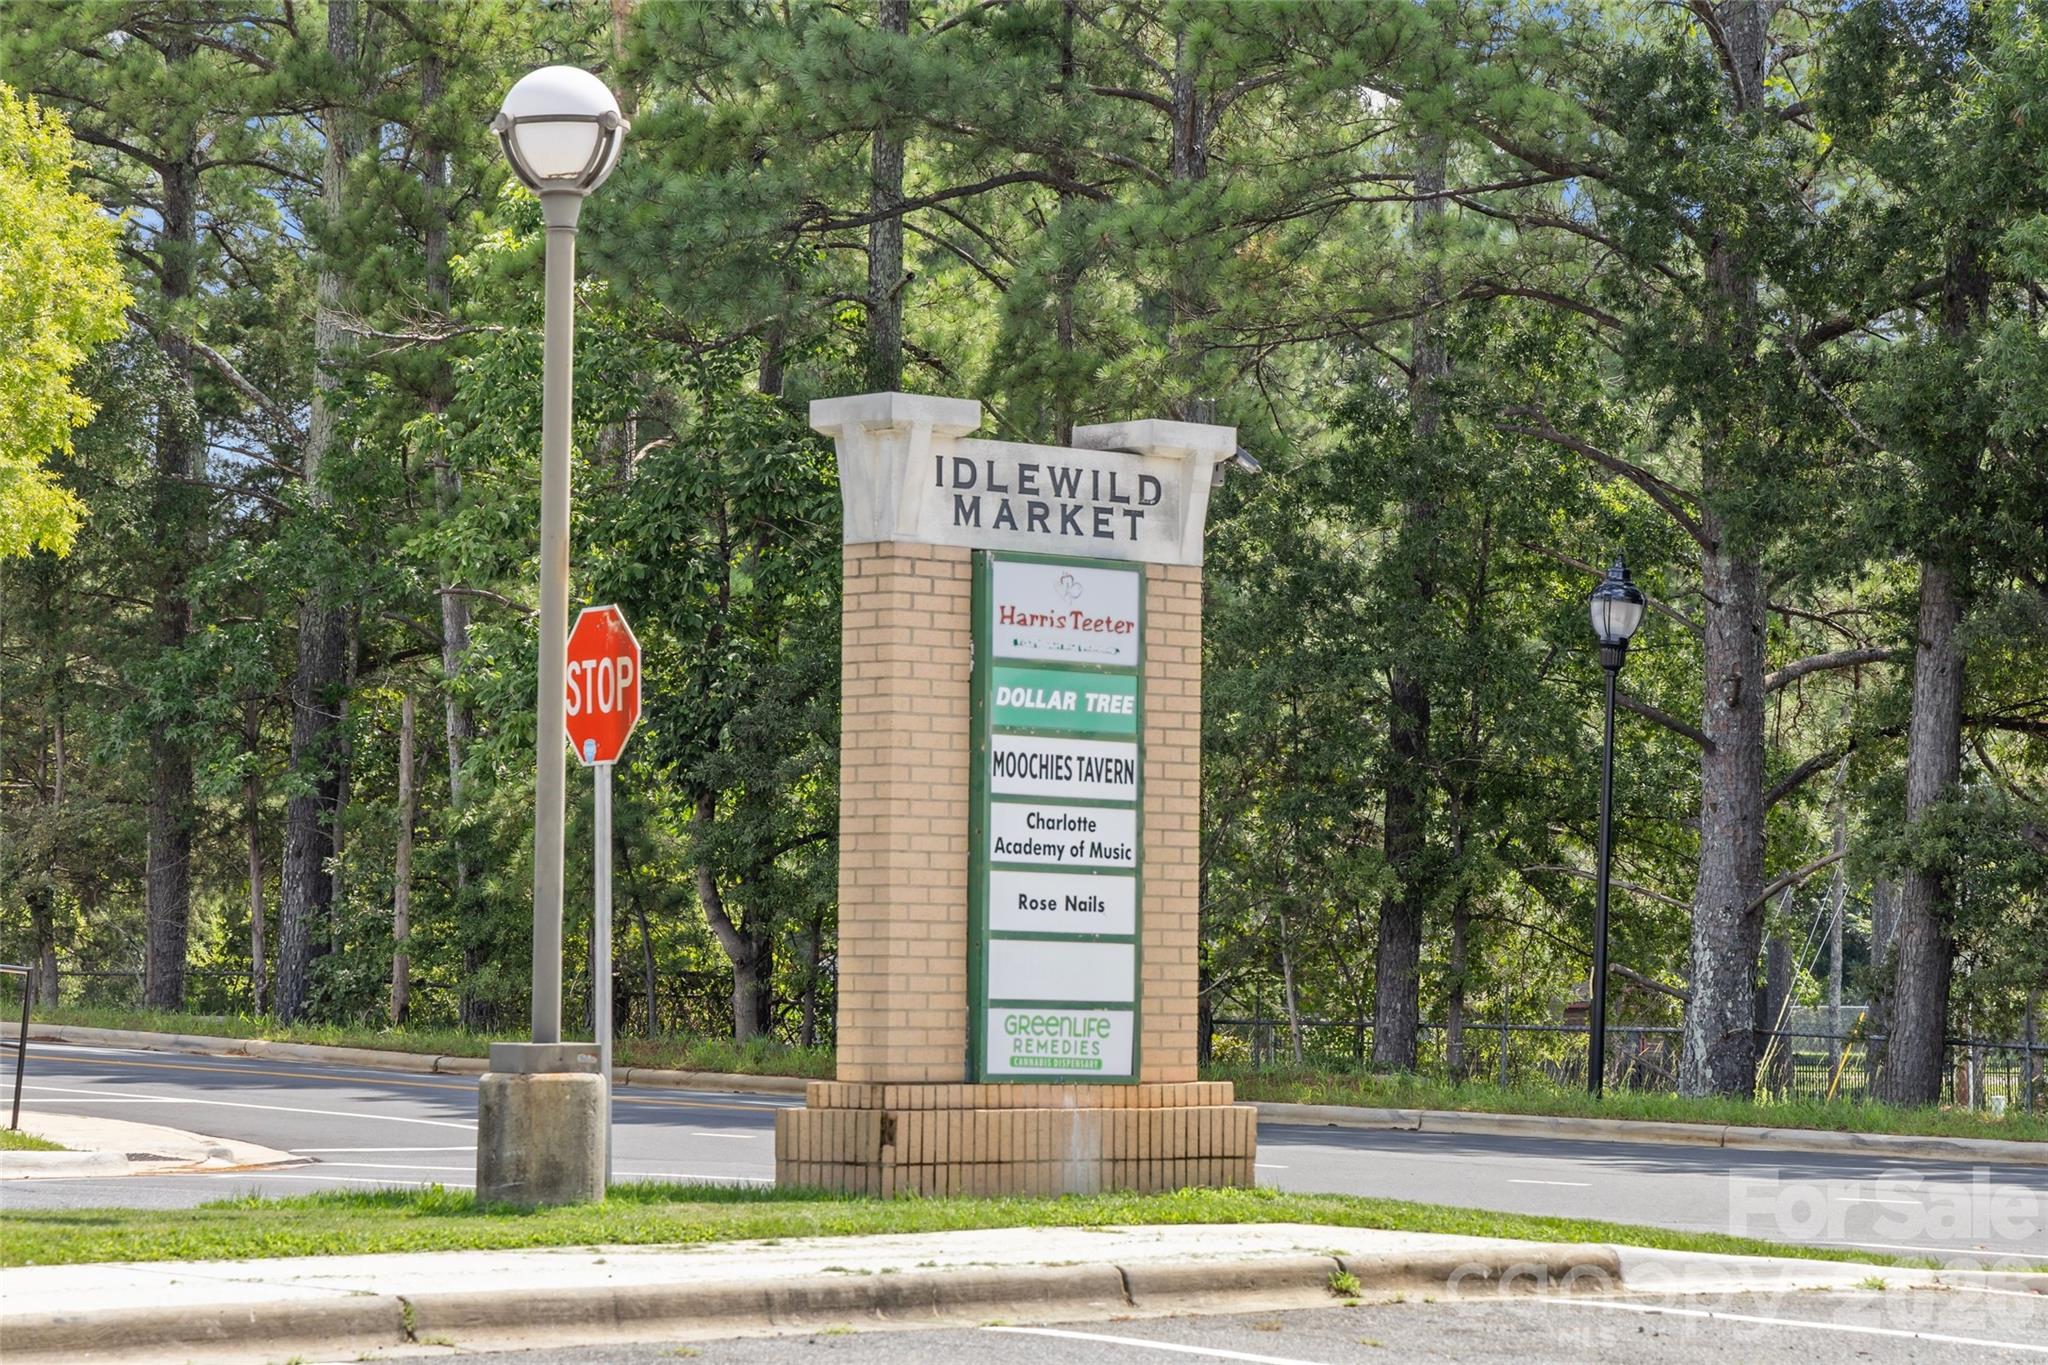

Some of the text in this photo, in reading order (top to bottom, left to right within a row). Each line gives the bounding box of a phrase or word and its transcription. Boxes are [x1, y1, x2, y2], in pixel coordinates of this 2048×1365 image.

[935, 455, 1162, 506] IDLEWILD
[953, 494, 1145, 541] MARKET
[999, 605, 1135, 634] Harris Teeter
[566, 656, 634, 717] STOP
[996, 686, 1135, 714] DOLLAR TREE
[993, 751, 1135, 784] MOOCHIES TAVERN
[1026, 812, 1097, 833] Charlotte
[994, 836, 1132, 861] Academy of Music
[1018, 893, 1105, 913] Rose Nails
[1013, 1038, 1100, 1056] REMEDIES
